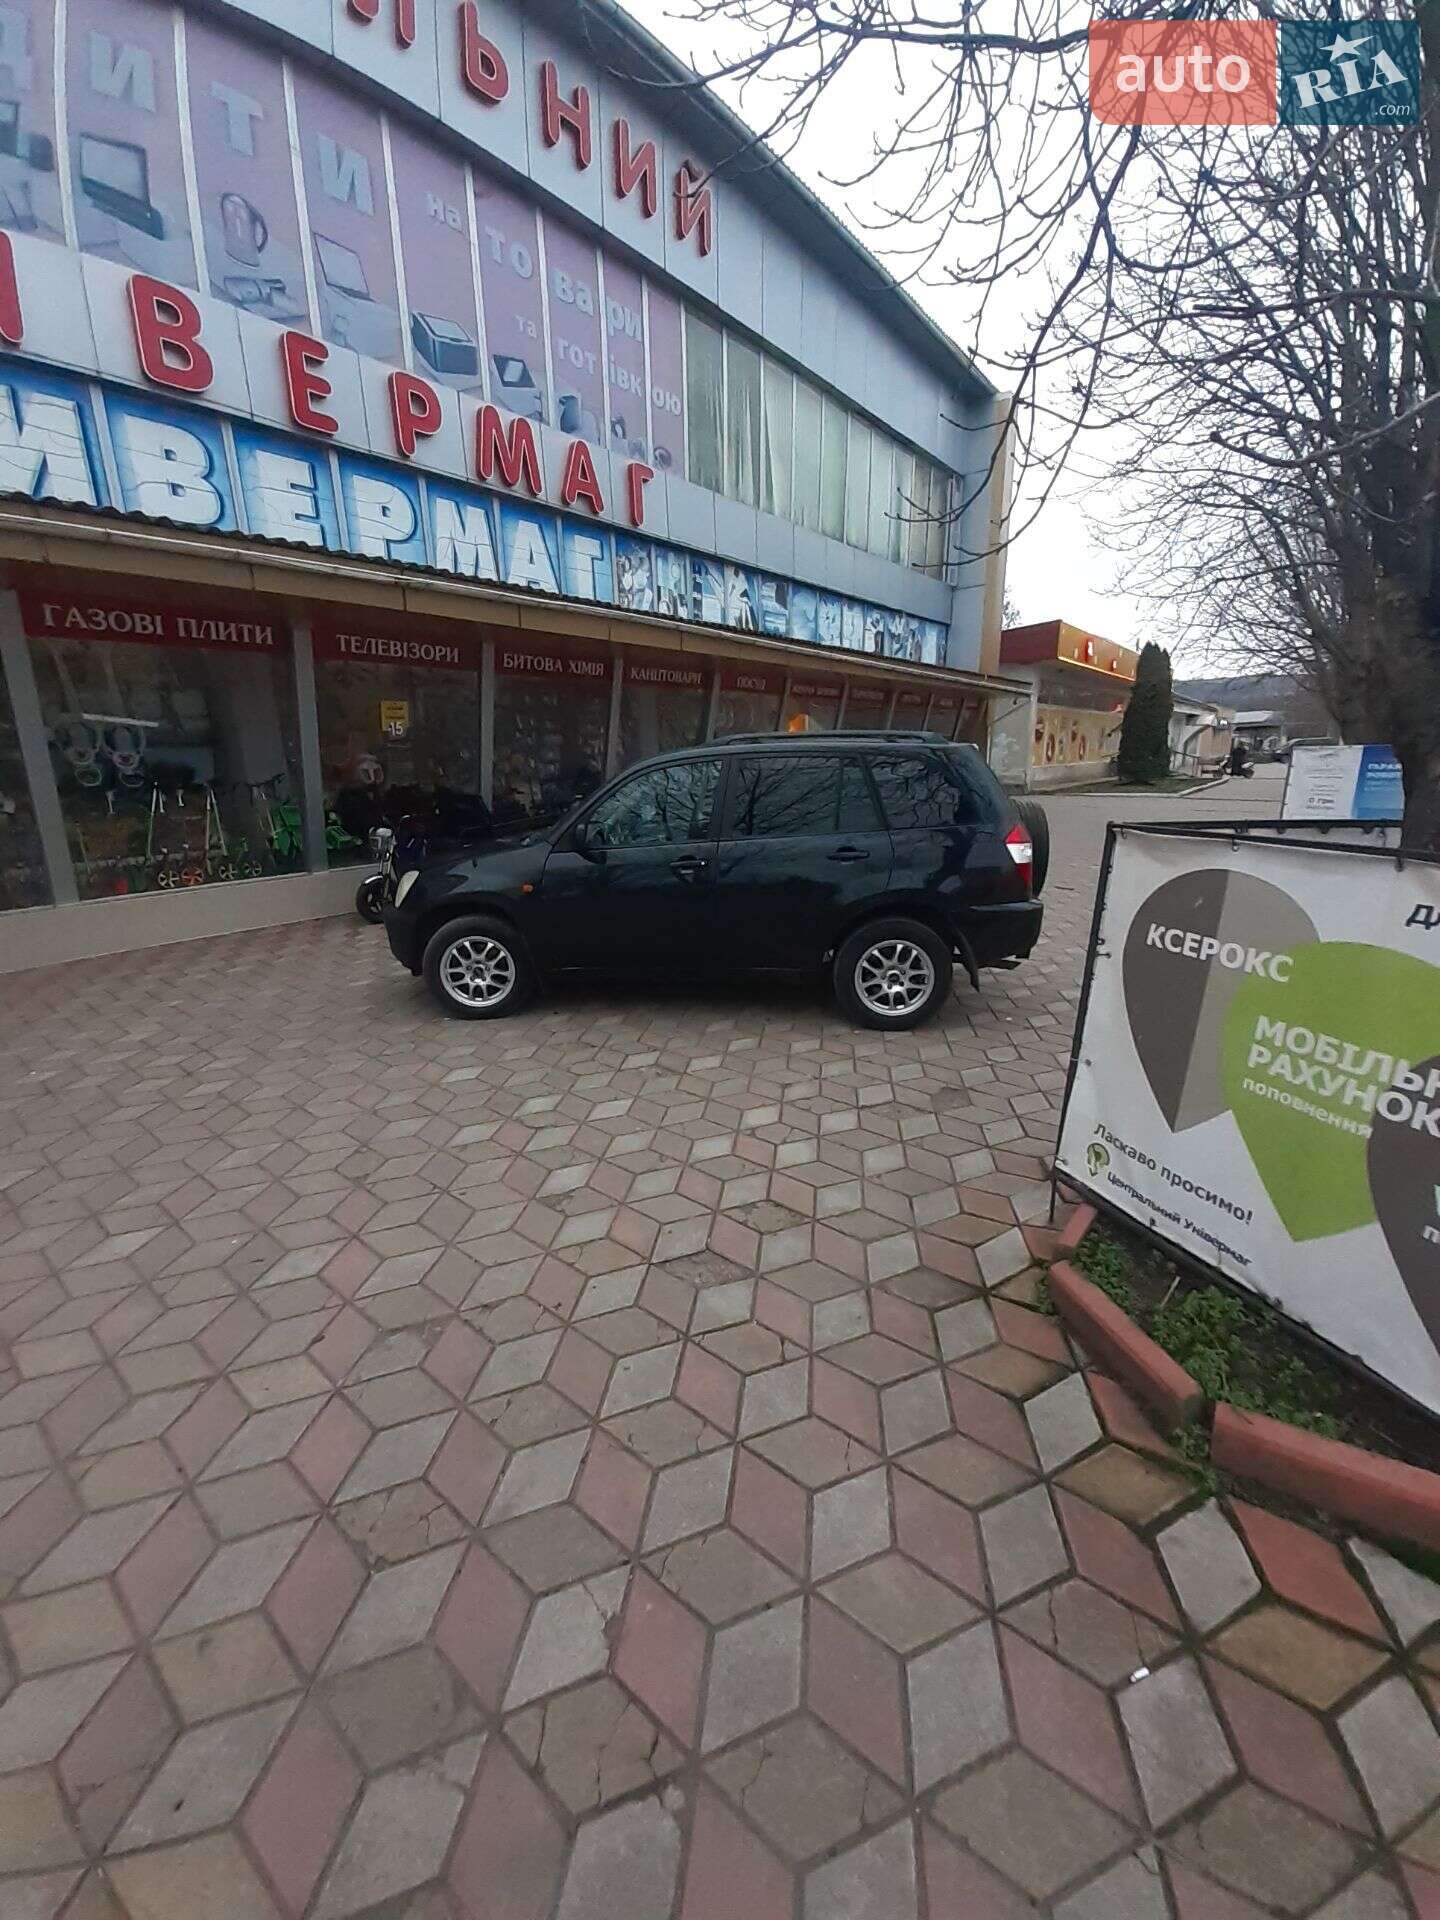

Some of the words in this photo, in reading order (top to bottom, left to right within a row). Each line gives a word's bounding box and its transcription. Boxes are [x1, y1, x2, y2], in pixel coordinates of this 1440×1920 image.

[42, 604, 163, 637] ГАЗОВІ
[177, 617, 274, 645] ПЛИТИ
[336, 634, 459, 664] ТЕЛЕВІЗОРИ
[502, 652, 563, 673] БИТОВА
[567, 659, 604, 677] ХІМІЯ
[1146, 922, 1294, 983] КСЕРОКС
[1242, 1077, 1373, 1139] поповнення
[1247, 1044, 1440, 1138] РАХУНОК
[1094, 1123, 1157, 1171] Ласкаво
[1160, 1166, 1253, 1226] просимо!
[1183, 1218, 1253, 1267] Універмаг
